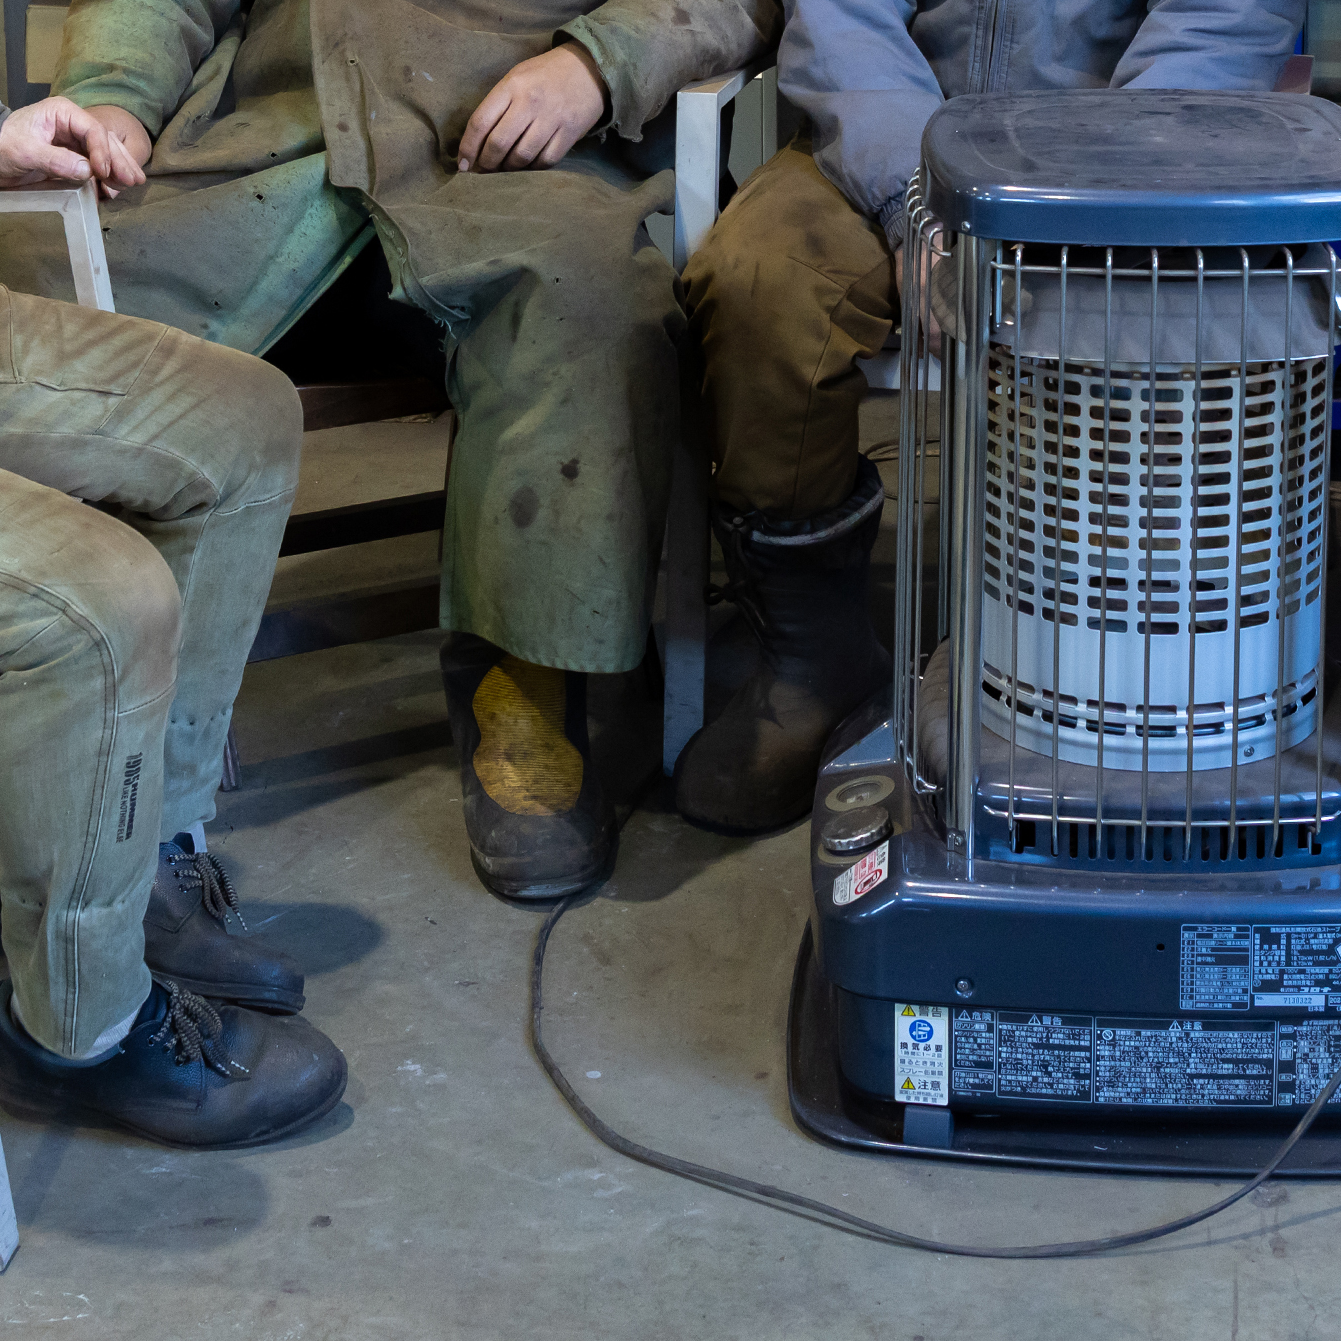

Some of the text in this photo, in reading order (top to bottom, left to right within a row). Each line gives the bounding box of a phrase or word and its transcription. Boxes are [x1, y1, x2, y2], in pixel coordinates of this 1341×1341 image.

[900, 1041, 943, 1052] 換気必要
[918, 1079, 941, 1091] 注意
